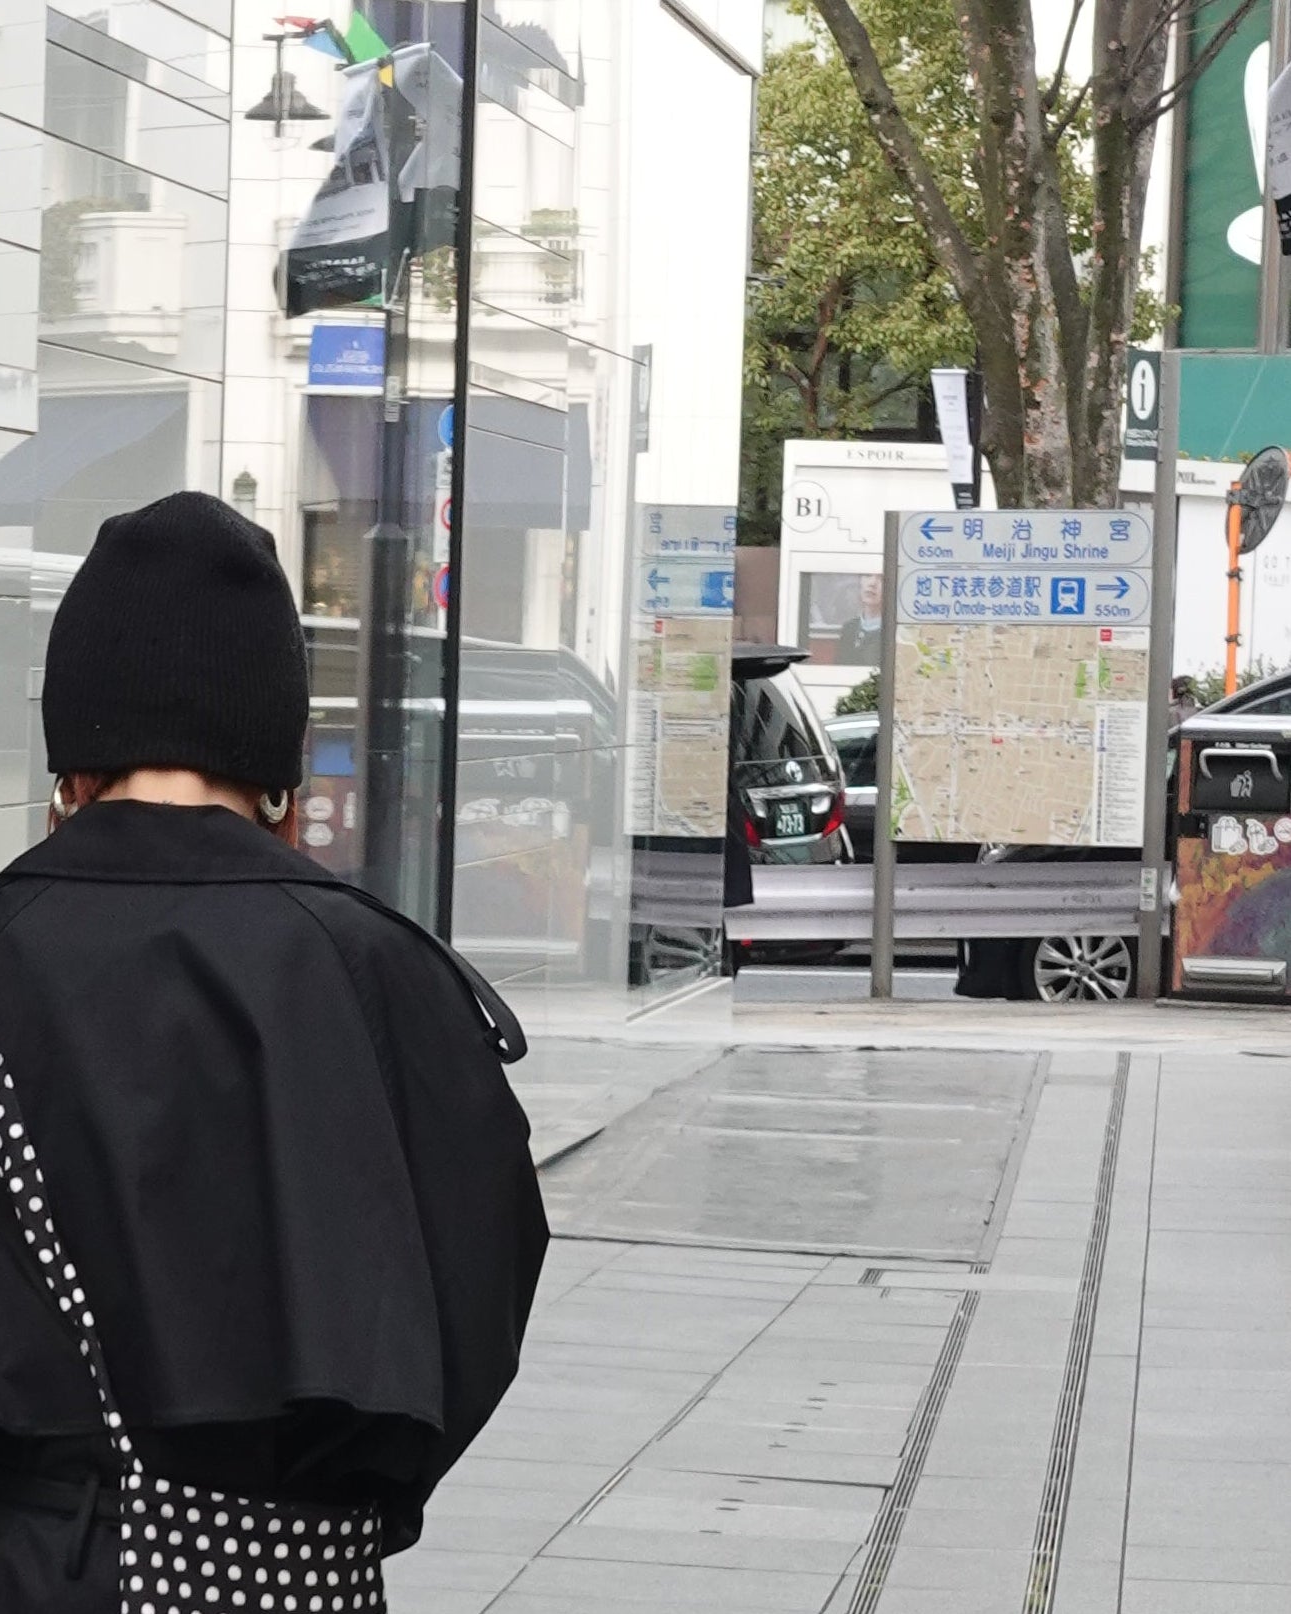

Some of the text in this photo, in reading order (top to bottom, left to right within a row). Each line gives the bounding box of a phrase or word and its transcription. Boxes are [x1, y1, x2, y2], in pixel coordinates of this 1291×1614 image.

[847, 448, 905, 461] ESPOIR
[796, 496, 822, 518] B1
[963, 517, 1131, 542] 明治神宮
[917, 545, 954, 559] 650m
[982, 542, 1109, 561] Meiji Jingu Shrine
[915, 575, 1042, 598] 地下鉄表参道駅
[913, 600, 951, 618] Subway
[1094, 604, 1131, 618] 550m
